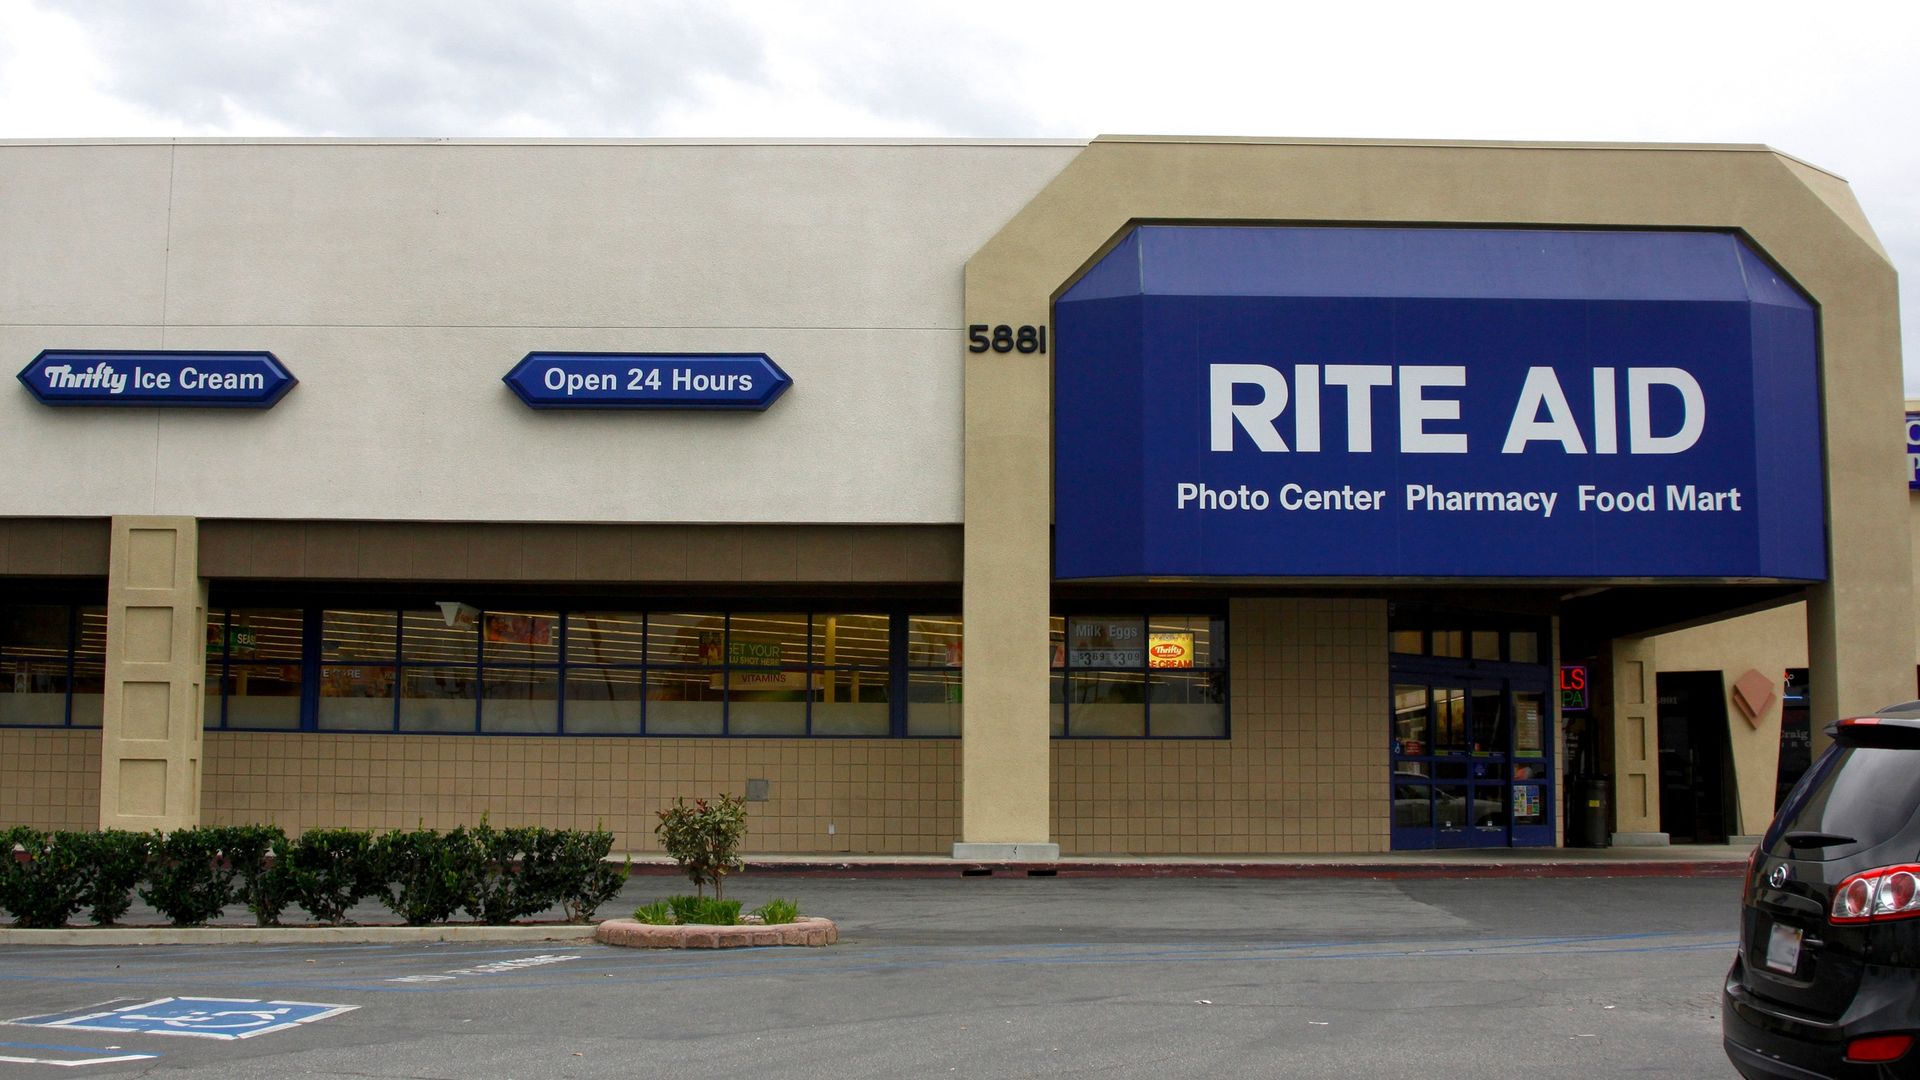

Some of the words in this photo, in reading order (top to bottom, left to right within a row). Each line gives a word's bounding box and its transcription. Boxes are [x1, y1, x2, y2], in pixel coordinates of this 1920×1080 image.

[969, 324, 1046, 354] 5881
[44, 362, 128, 395] Thrifty
[134, 366, 171, 390] Ice
[179, 367, 264, 391] Cream
[543, 367, 617, 396] Open
[627, 368, 663, 391] 24
[671, 368, 753, 392] Hours
[1209, 363, 1468, 454] RITE
[1501, 365, 1706, 455] AID
[1176, 482, 1270, 511] Photo
[1279, 483, 1386, 511] Center
[1405, 483, 1558, 518] Pharmacy
[1577, 484, 1655, 512] Food
[1666, 484, 1742, 512] Mart
[1076, 624, 1102, 637] Milk
[1109, 624, 1138, 640] Eggs
[748, 644, 780, 658] YOUR
[1154, 644, 1182, 655] Thrifty
[742, 673, 786, 683] VITAMINS
[1561, 668, 1585, 690] LS
